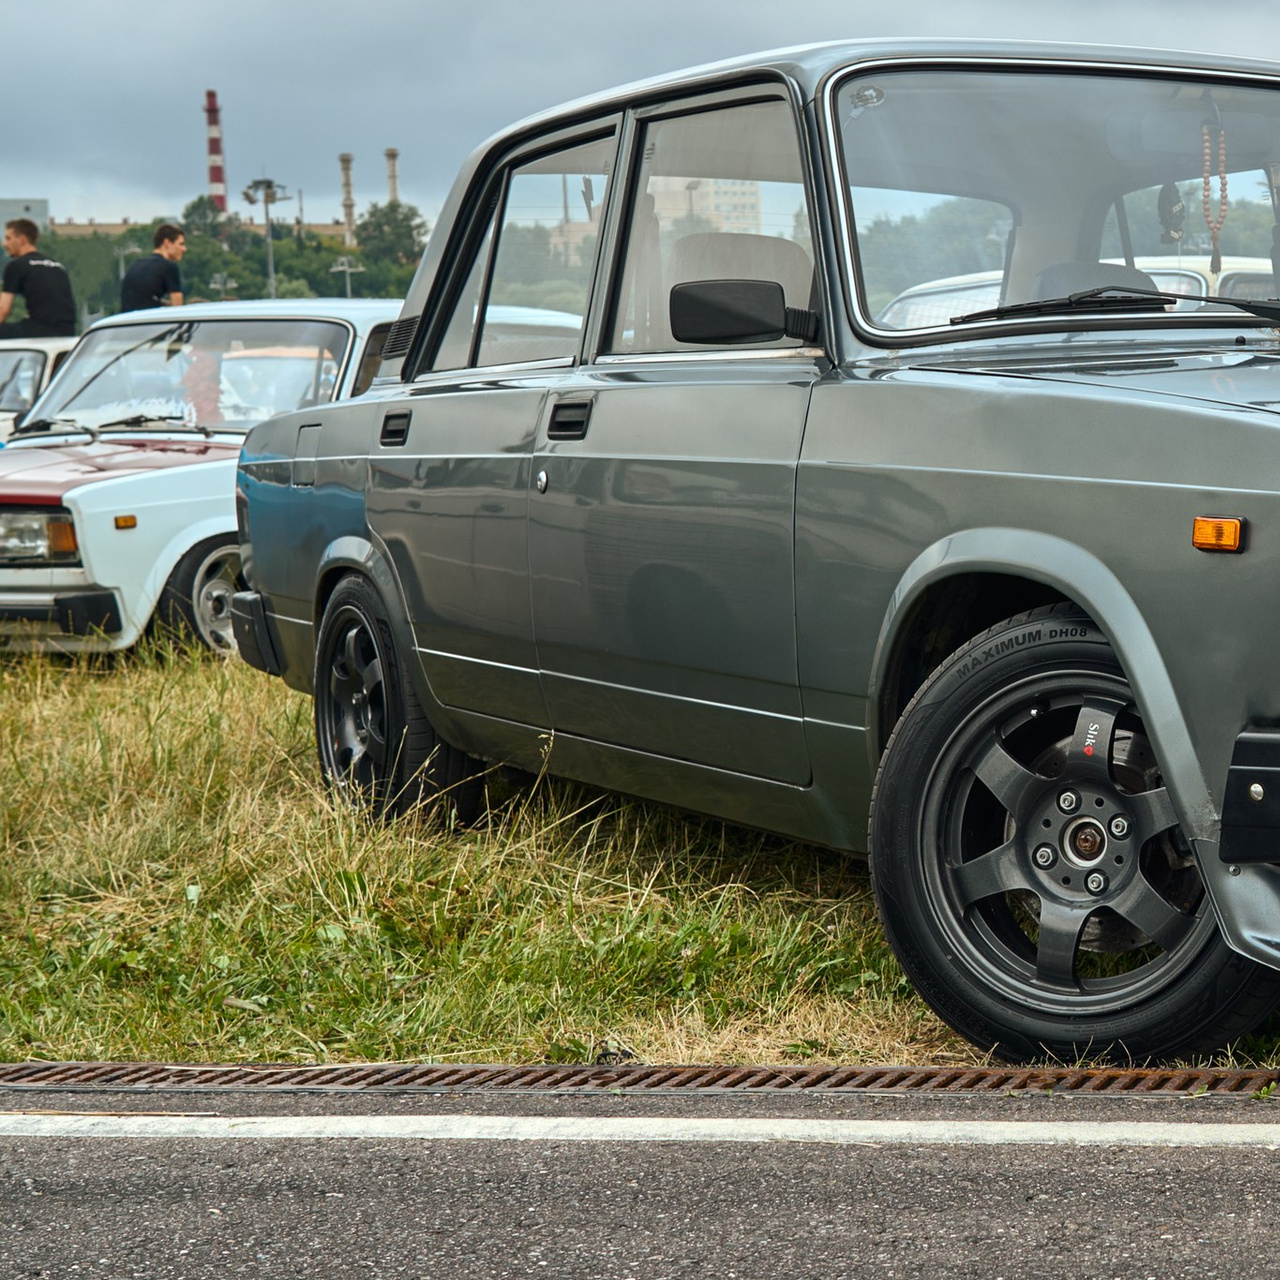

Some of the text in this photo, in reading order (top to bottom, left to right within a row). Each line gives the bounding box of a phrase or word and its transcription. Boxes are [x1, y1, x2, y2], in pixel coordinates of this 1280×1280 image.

[956, 627, 1088, 680] MAXIMUM DH08
[1084, 722, 1100, 746] Slik
